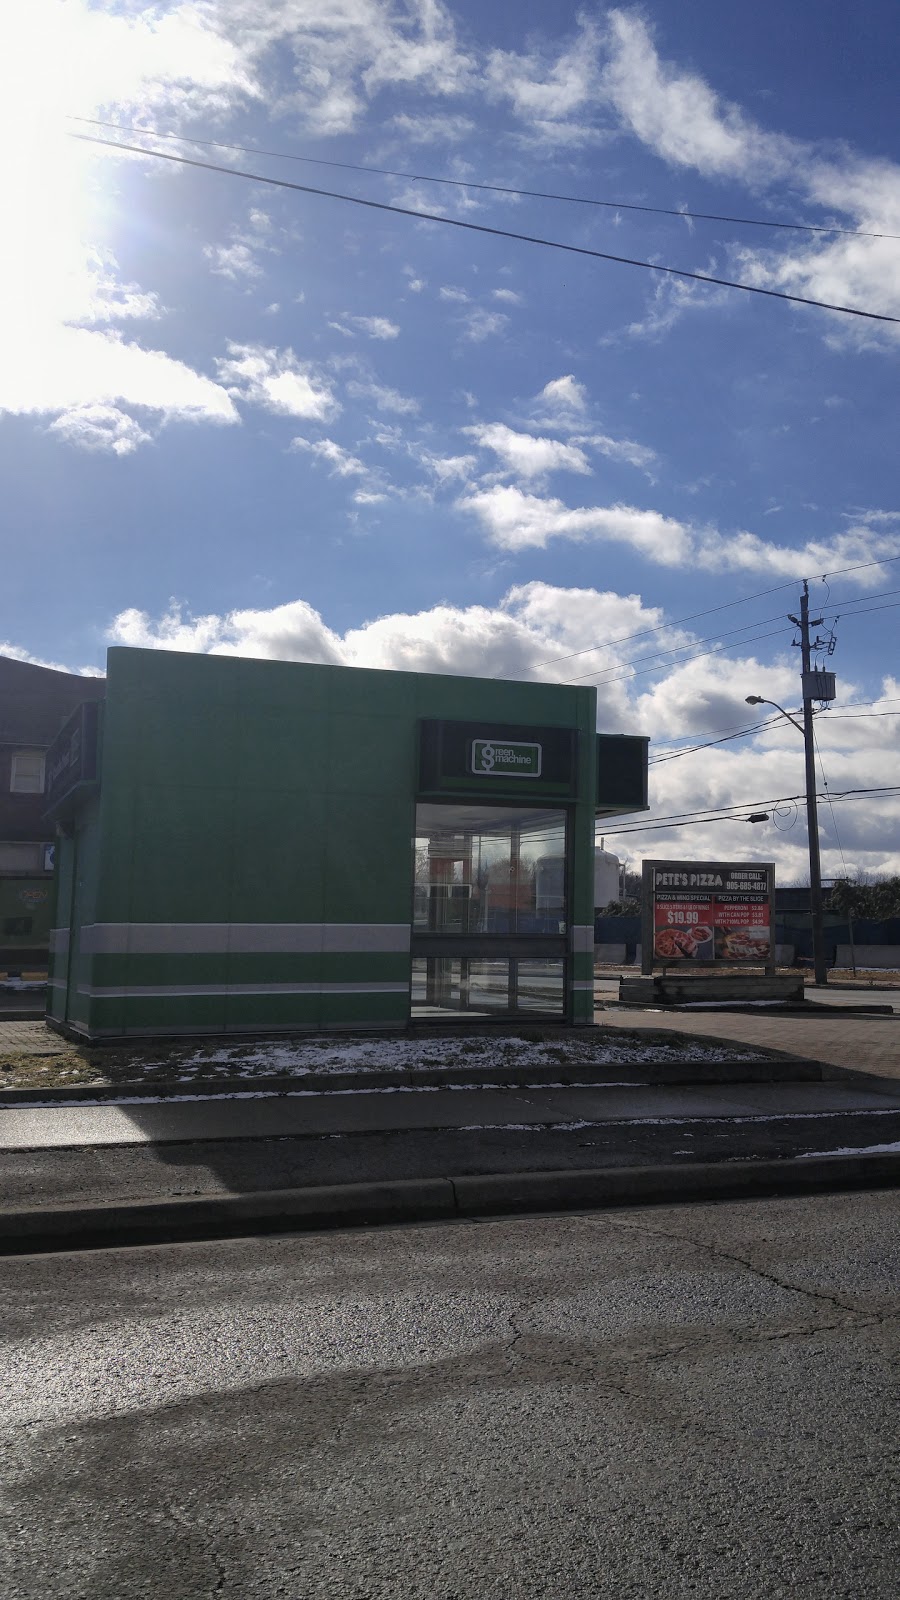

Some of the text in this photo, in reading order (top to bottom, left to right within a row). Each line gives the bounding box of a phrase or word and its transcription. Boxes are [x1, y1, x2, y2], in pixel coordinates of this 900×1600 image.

[495, 755, 532, 764] machine
[656, 873, 723, 887] PETE'S PIZZA
[730, 872, 748, 880] ORDER
[726, 881, 767, 891] 905-685-4877
[667, 910, 699, 924] $19.99
